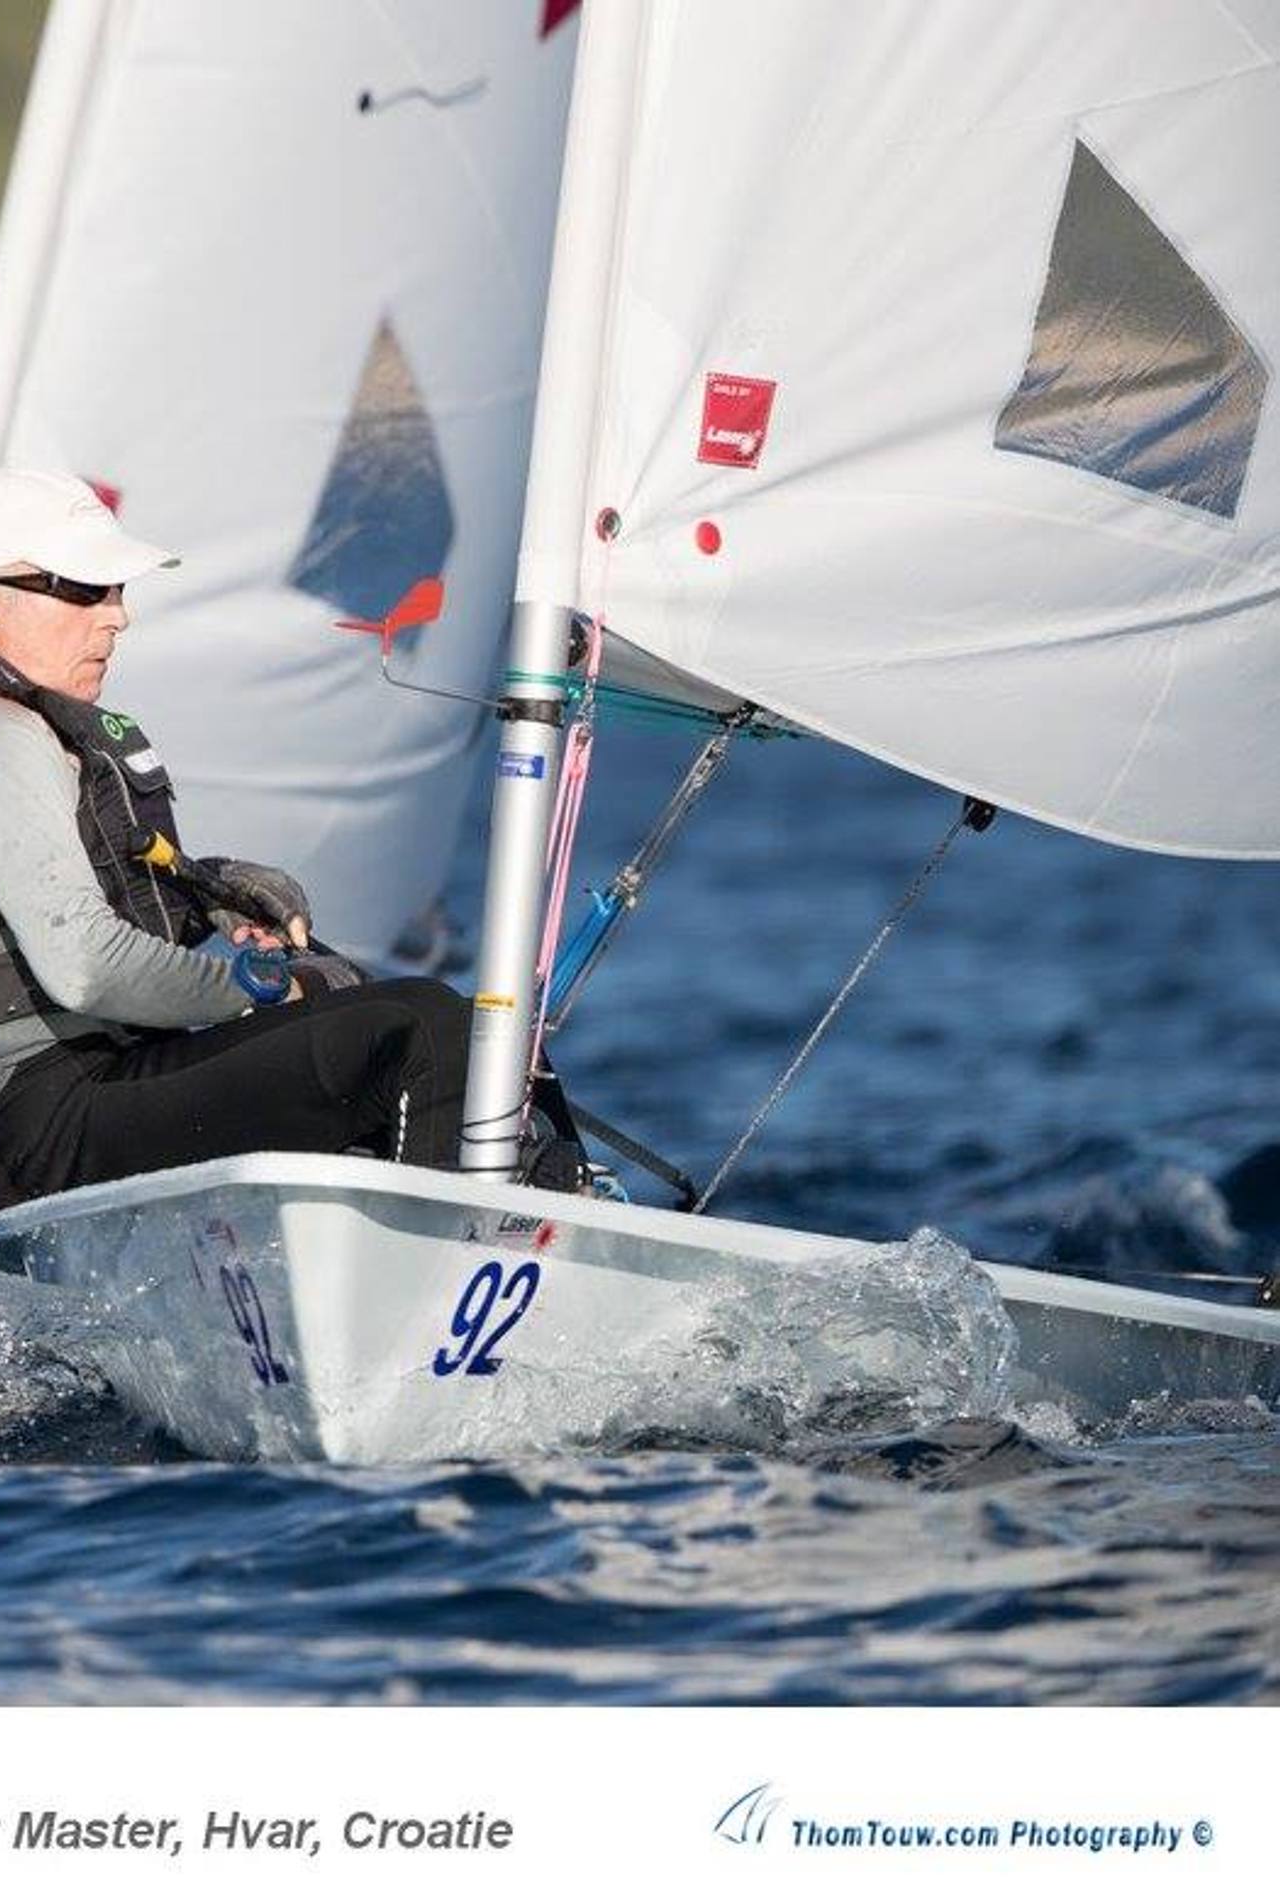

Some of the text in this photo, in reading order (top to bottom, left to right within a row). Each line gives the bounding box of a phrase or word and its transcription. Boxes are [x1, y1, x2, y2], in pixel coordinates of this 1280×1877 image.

[705, 425, 751, 447] Laser
[498, 1211, 542, 1232] Laser
[220, 1262, 290, 1387] 92
[433, 1260, 540, 1377] 92
